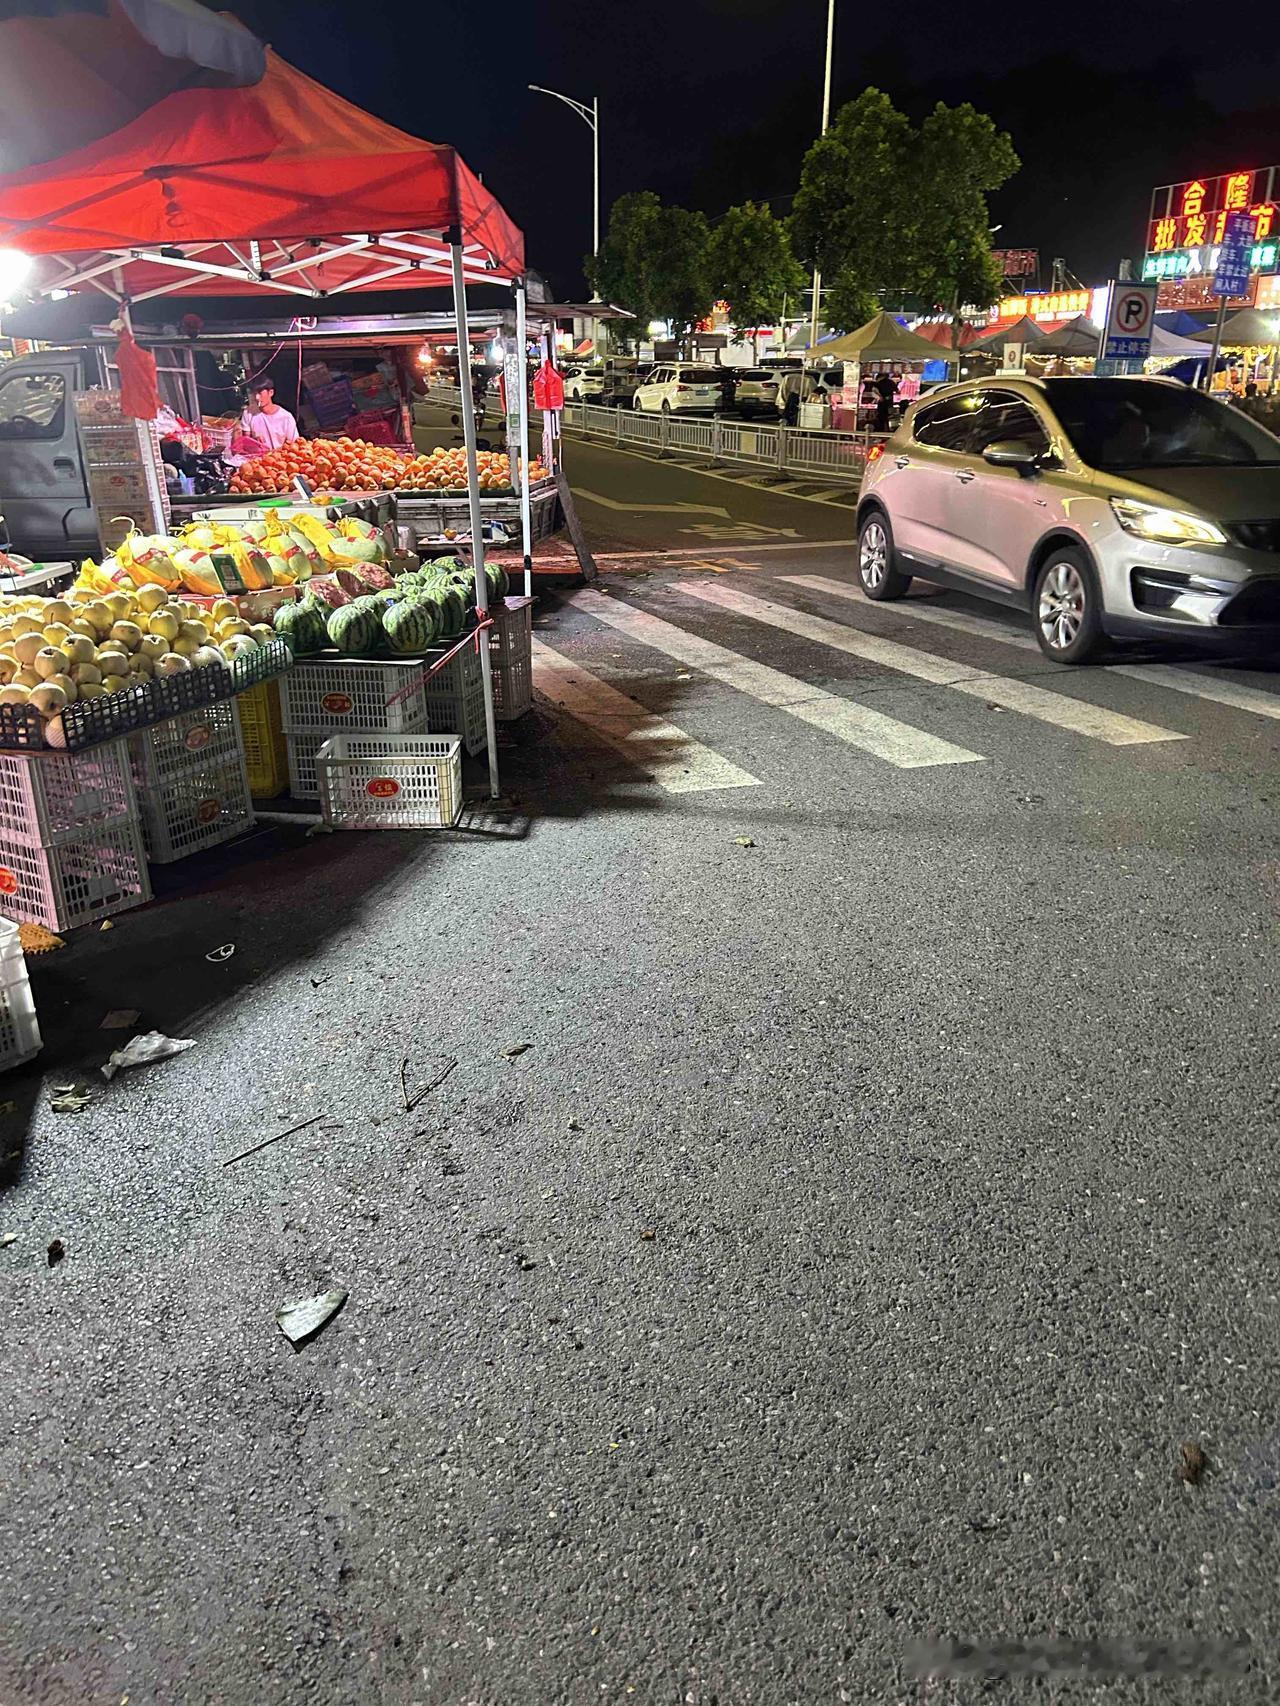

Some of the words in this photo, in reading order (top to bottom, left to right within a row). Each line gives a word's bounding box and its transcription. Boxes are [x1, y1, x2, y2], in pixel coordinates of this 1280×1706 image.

[1184, 174, 1250, 214] 合隆
[1106, 341, 1150, 355] 禁止停车
